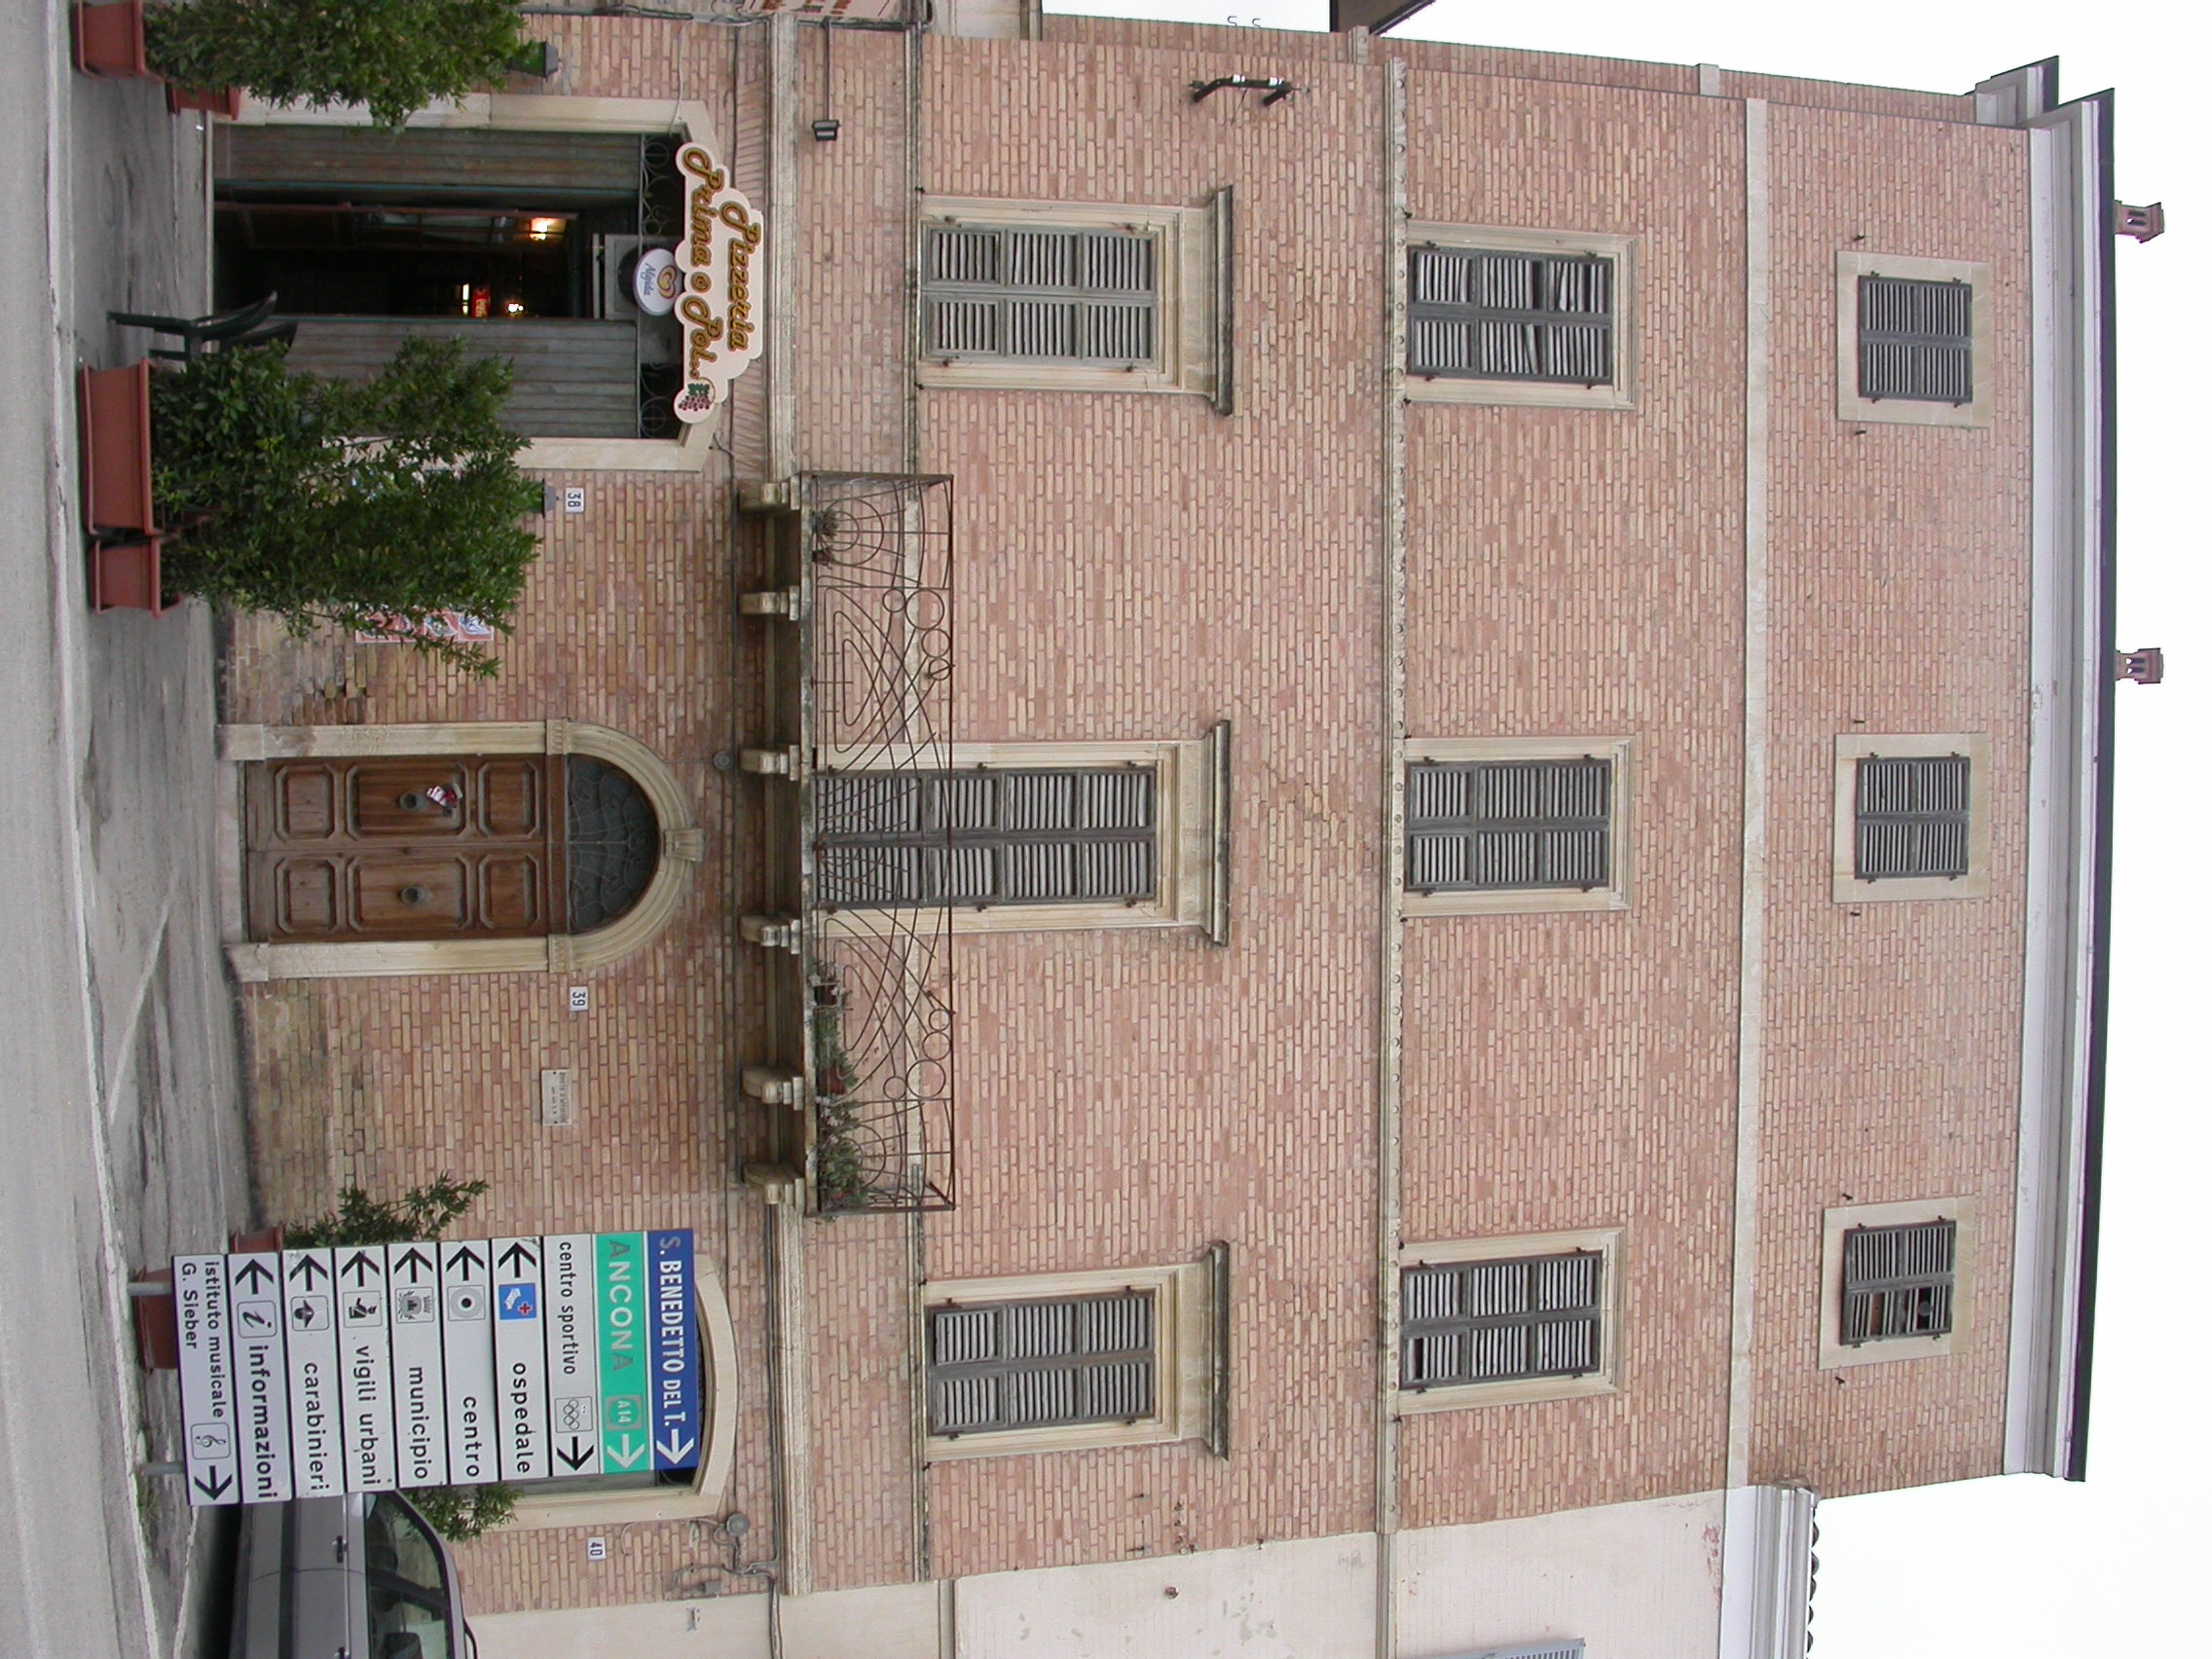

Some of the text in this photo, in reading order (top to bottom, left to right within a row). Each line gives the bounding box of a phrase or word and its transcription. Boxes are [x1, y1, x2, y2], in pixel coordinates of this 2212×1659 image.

[682, 147, 724, 267] Prima
[641, 263, 656, 296] Algida
[691, 273, 712, 294] o
[720, 203, 761, 351] Pizzeria
[568, 493, 581, 507] 38
[572, 992, 586, 1007] 39
[182, 1263, 199, 1349] G. Sieber
[204, 1262, 226, 1418] istituto musicale
[558, 1242, 578, 1375] centro sportivo
[608, 1240, 633, 1371] ANCONA
[659, 1236, 685, 1426] S. BENEDETTO DEL T.
[249, 1346, 277, 1497] informazioni
[304, 1363, 329, 1490] carabinieri
[353, 1346, 380, 1485] vigili urbani
[409, 1367, 432, 1479] municipio
[463, 1396, 483, 1477] centro
[510, 1363, 535, 1473] ospedale
[617, 1400, 632, 1423] A14
[590, 1542, 603, 1556] 40
